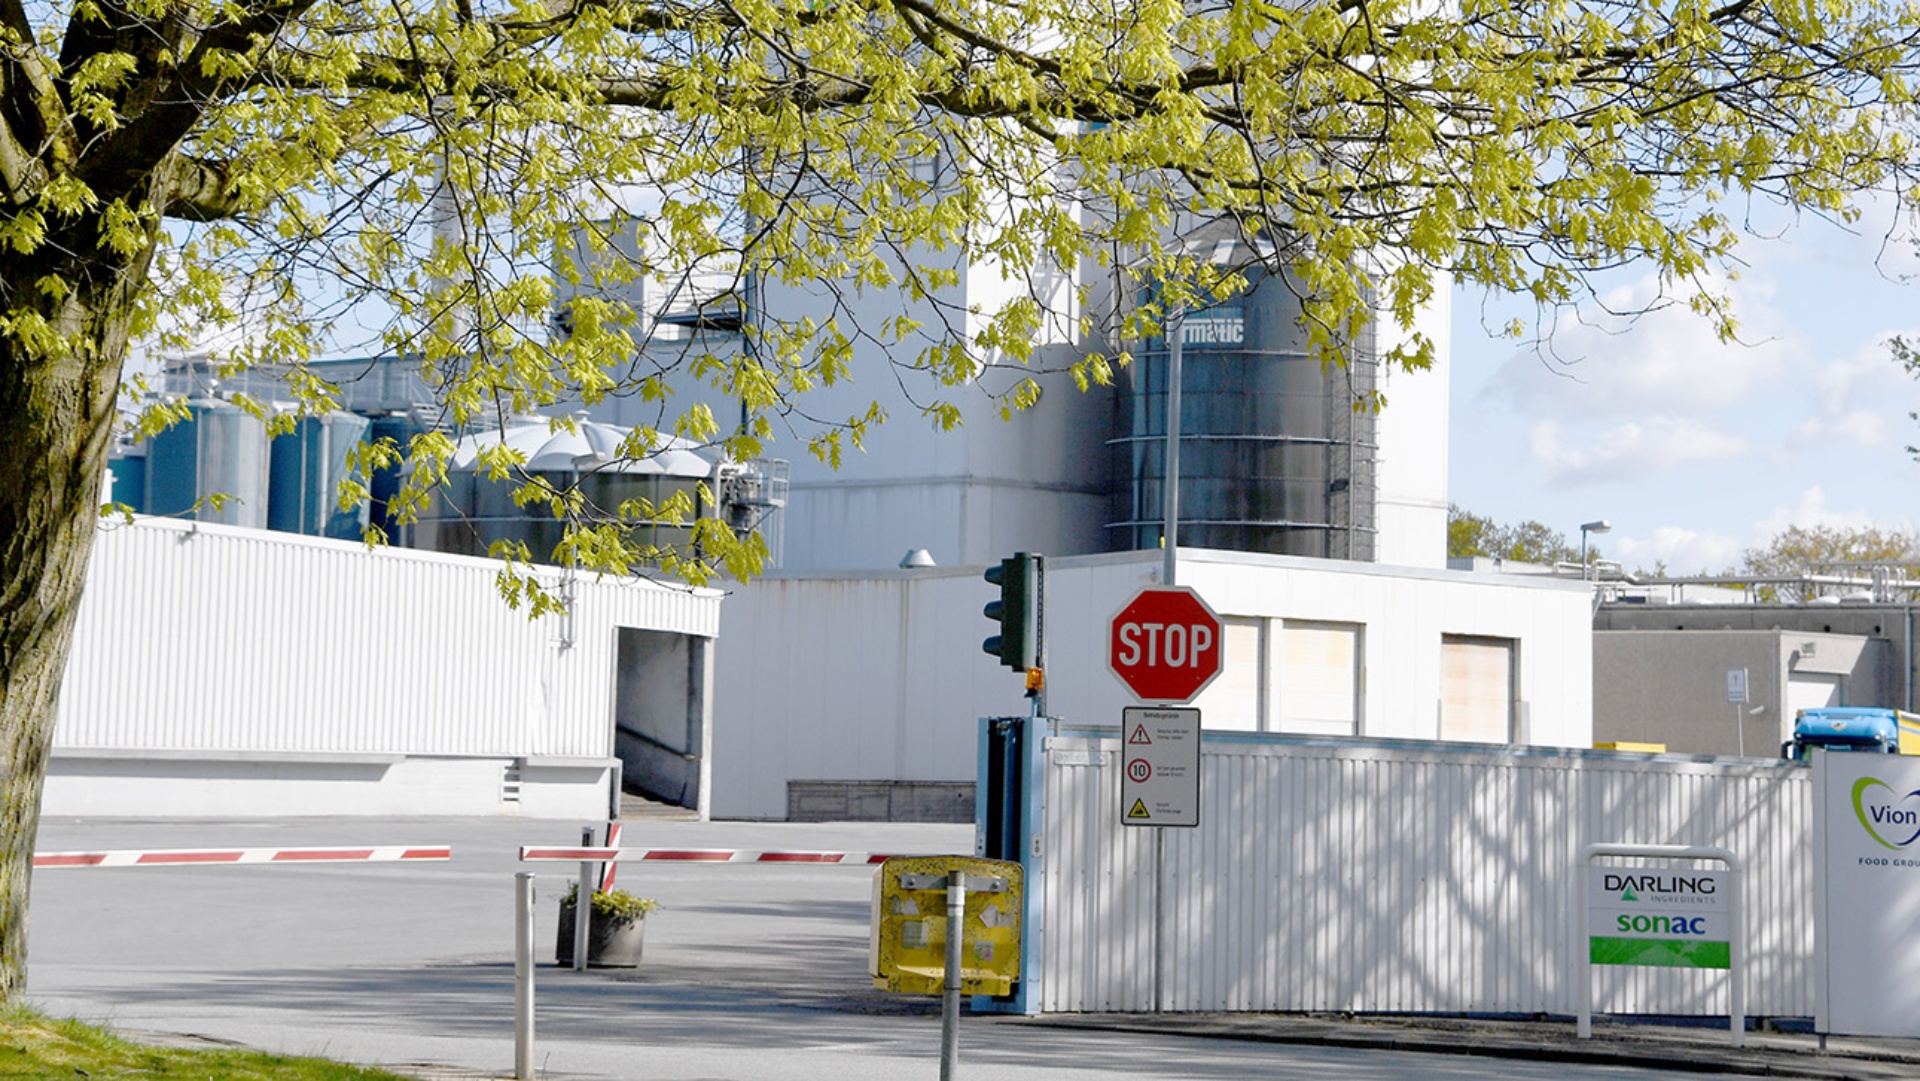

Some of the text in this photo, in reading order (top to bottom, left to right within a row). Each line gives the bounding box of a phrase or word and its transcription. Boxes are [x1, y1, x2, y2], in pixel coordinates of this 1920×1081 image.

[1119, 622, 1212, 668] STOP
[1133, 764, 1146, 777] 10
[1870, 805, 1917, 824] Vion
[1858, 857, 1889, 866] FOOD
[1604, 875, 1716, 894] DARLING
[1650, 895, 1716, 904] INGREDIENTS
[1617, 914, 1706, 935] sonac
